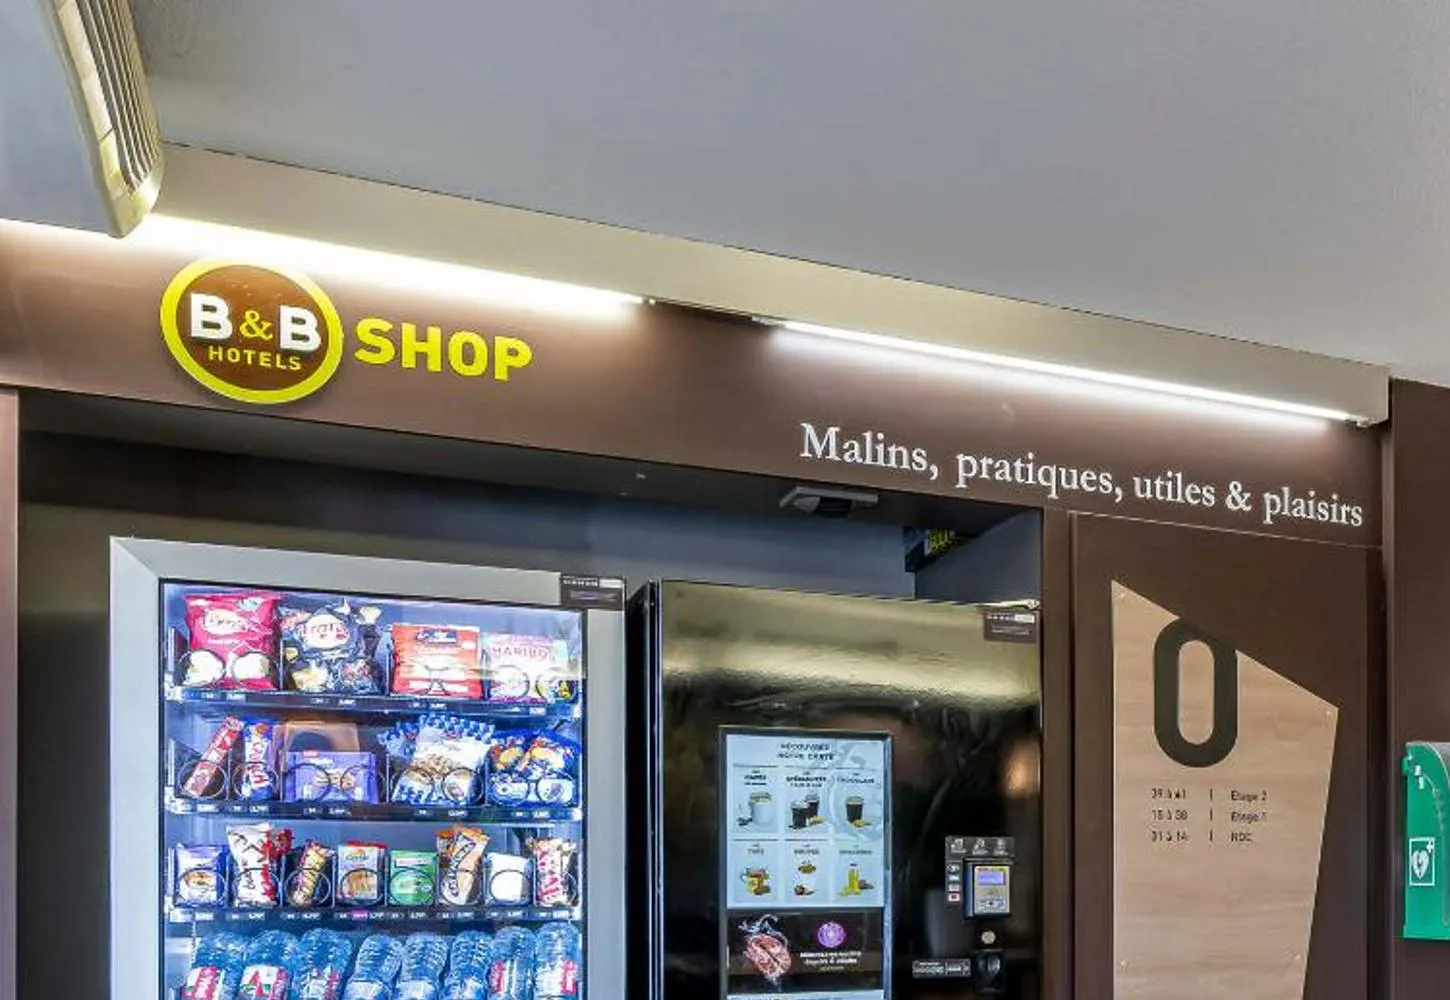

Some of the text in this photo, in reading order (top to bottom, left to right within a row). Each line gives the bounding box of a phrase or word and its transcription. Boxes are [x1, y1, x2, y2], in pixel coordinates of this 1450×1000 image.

[207, 344, 302, 372] HOTELS
[354, 317, 533, 381] SHOP
[800, 422, 1363, 527] Malins, pratiques, utiles & plaisirs
